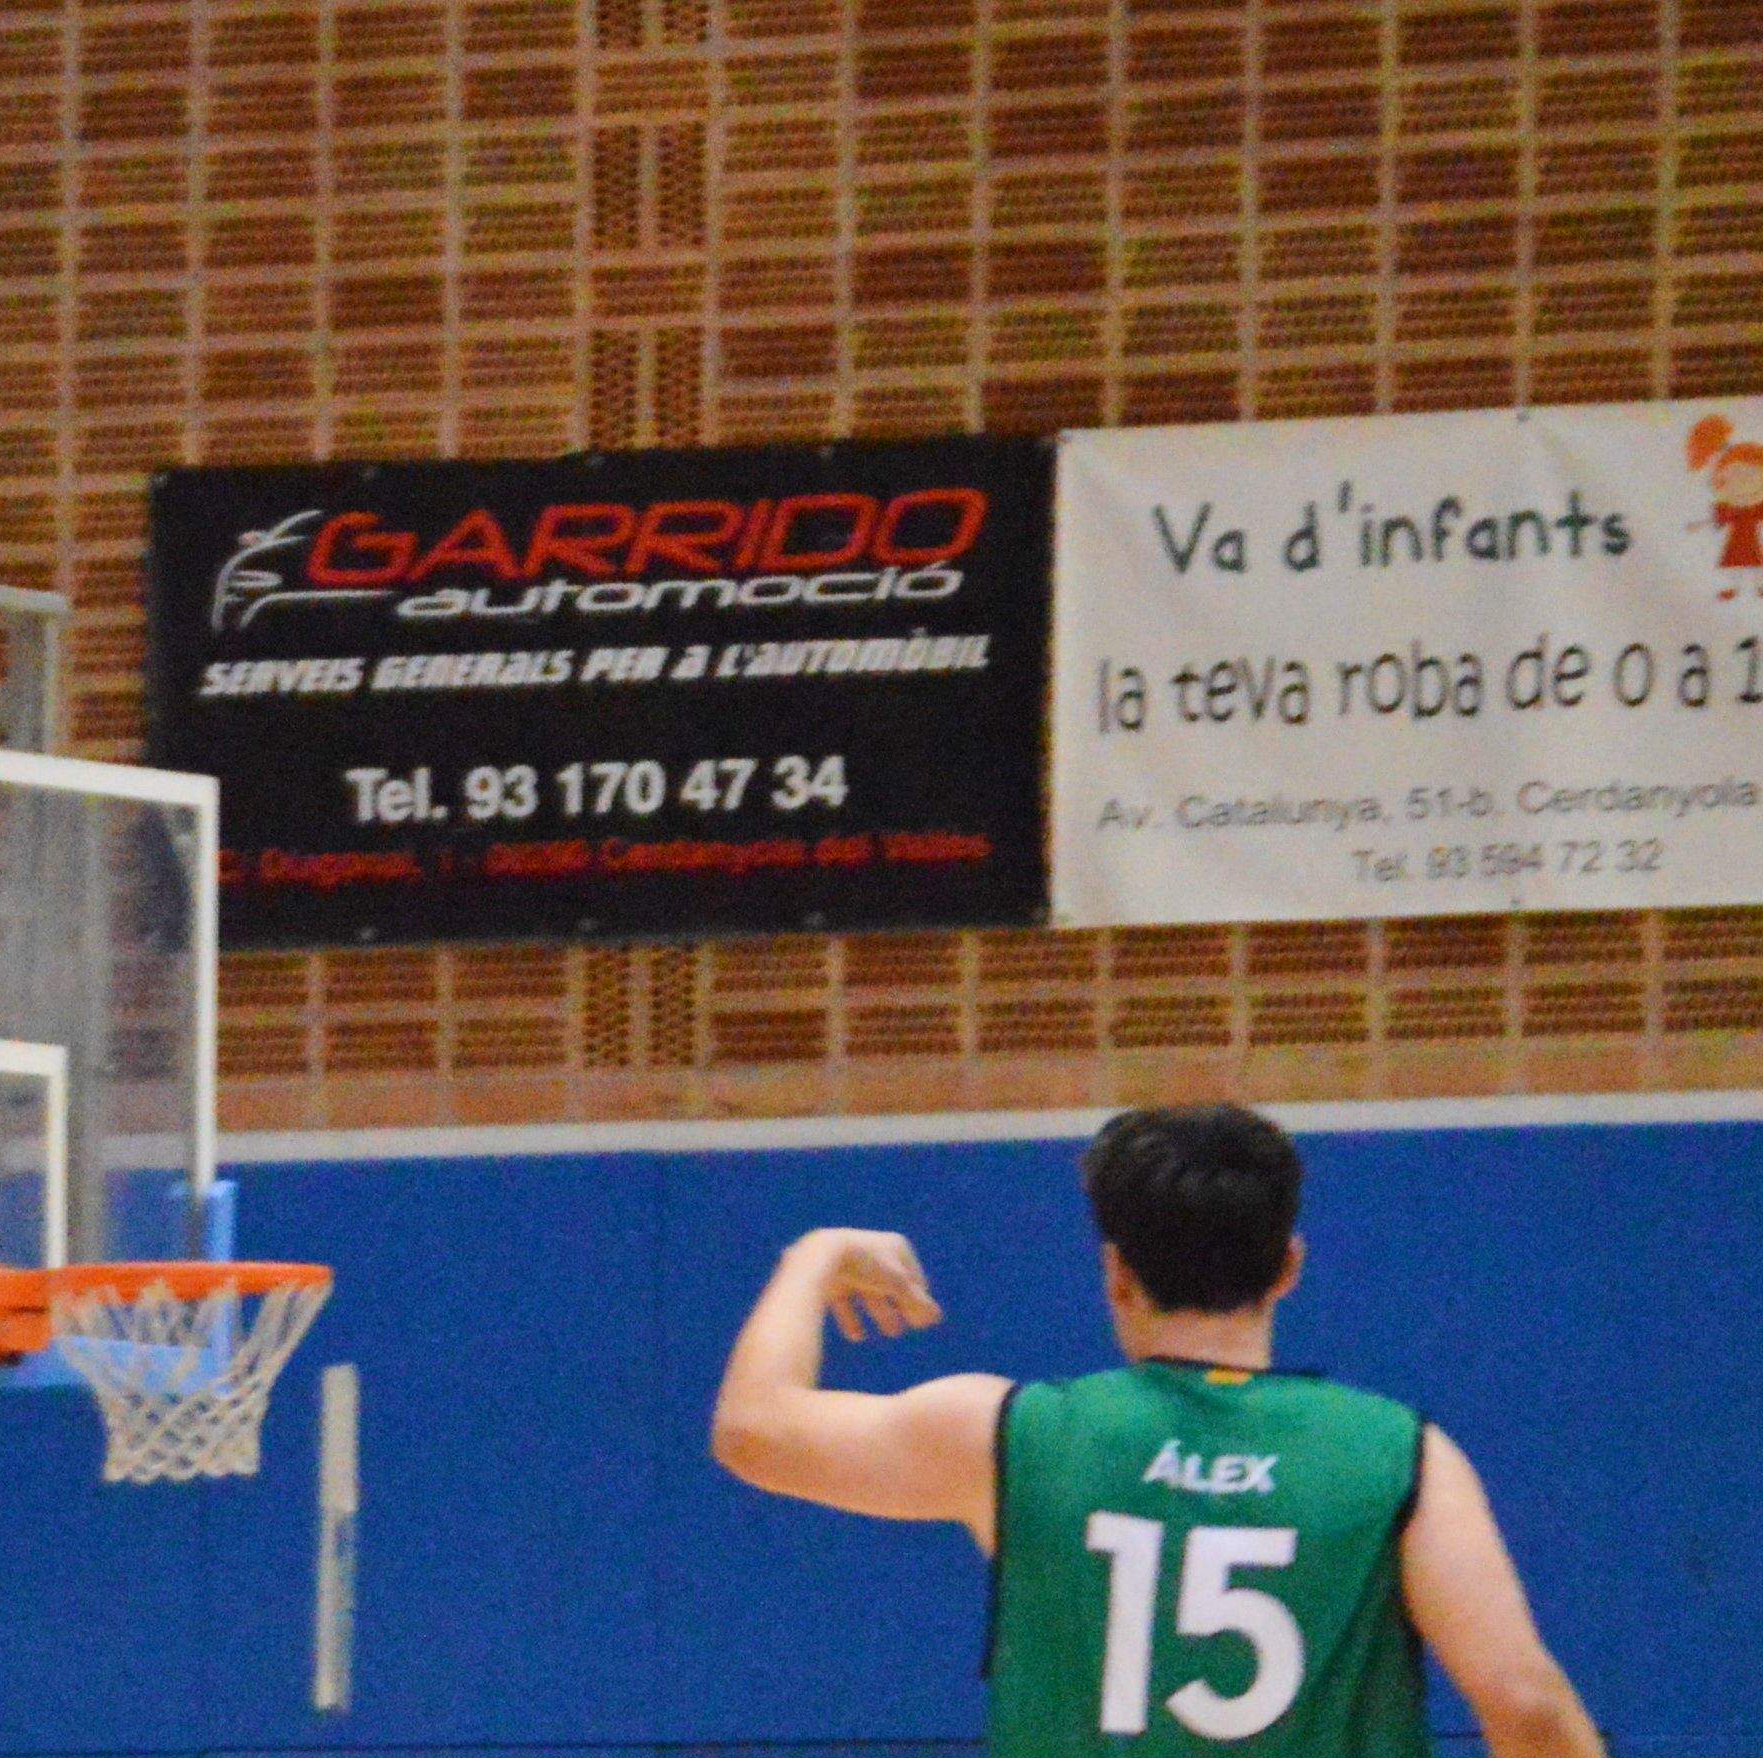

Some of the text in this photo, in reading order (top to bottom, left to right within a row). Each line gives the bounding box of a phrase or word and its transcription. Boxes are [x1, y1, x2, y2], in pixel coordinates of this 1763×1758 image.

[307, 488, 988, 585] GARRIDO
[1152, 480, 1634, 575] Va d'infants
[395, 560, 965, 618] automoció
[197, 656, 367, 698] SERVEIS
[580, 645, 670, 682] PER
[1097, 657, 1147, 735] la
[1168, 652, 1313, 726] teva
[1335, 640, 1483, 720] roba
[1505, 630, 1591, 711] de
[1678, 643, 1712, 710] a
[343, 754, 849, 823] Tel. 93 170 47 34
[1558, 841, 1602, 874] 72
[1617, 838, 1664, 874] 32
[1142, 1439, 1279, 1495] ÁLEX
[1084, 1509, 1306, 1742] 15
